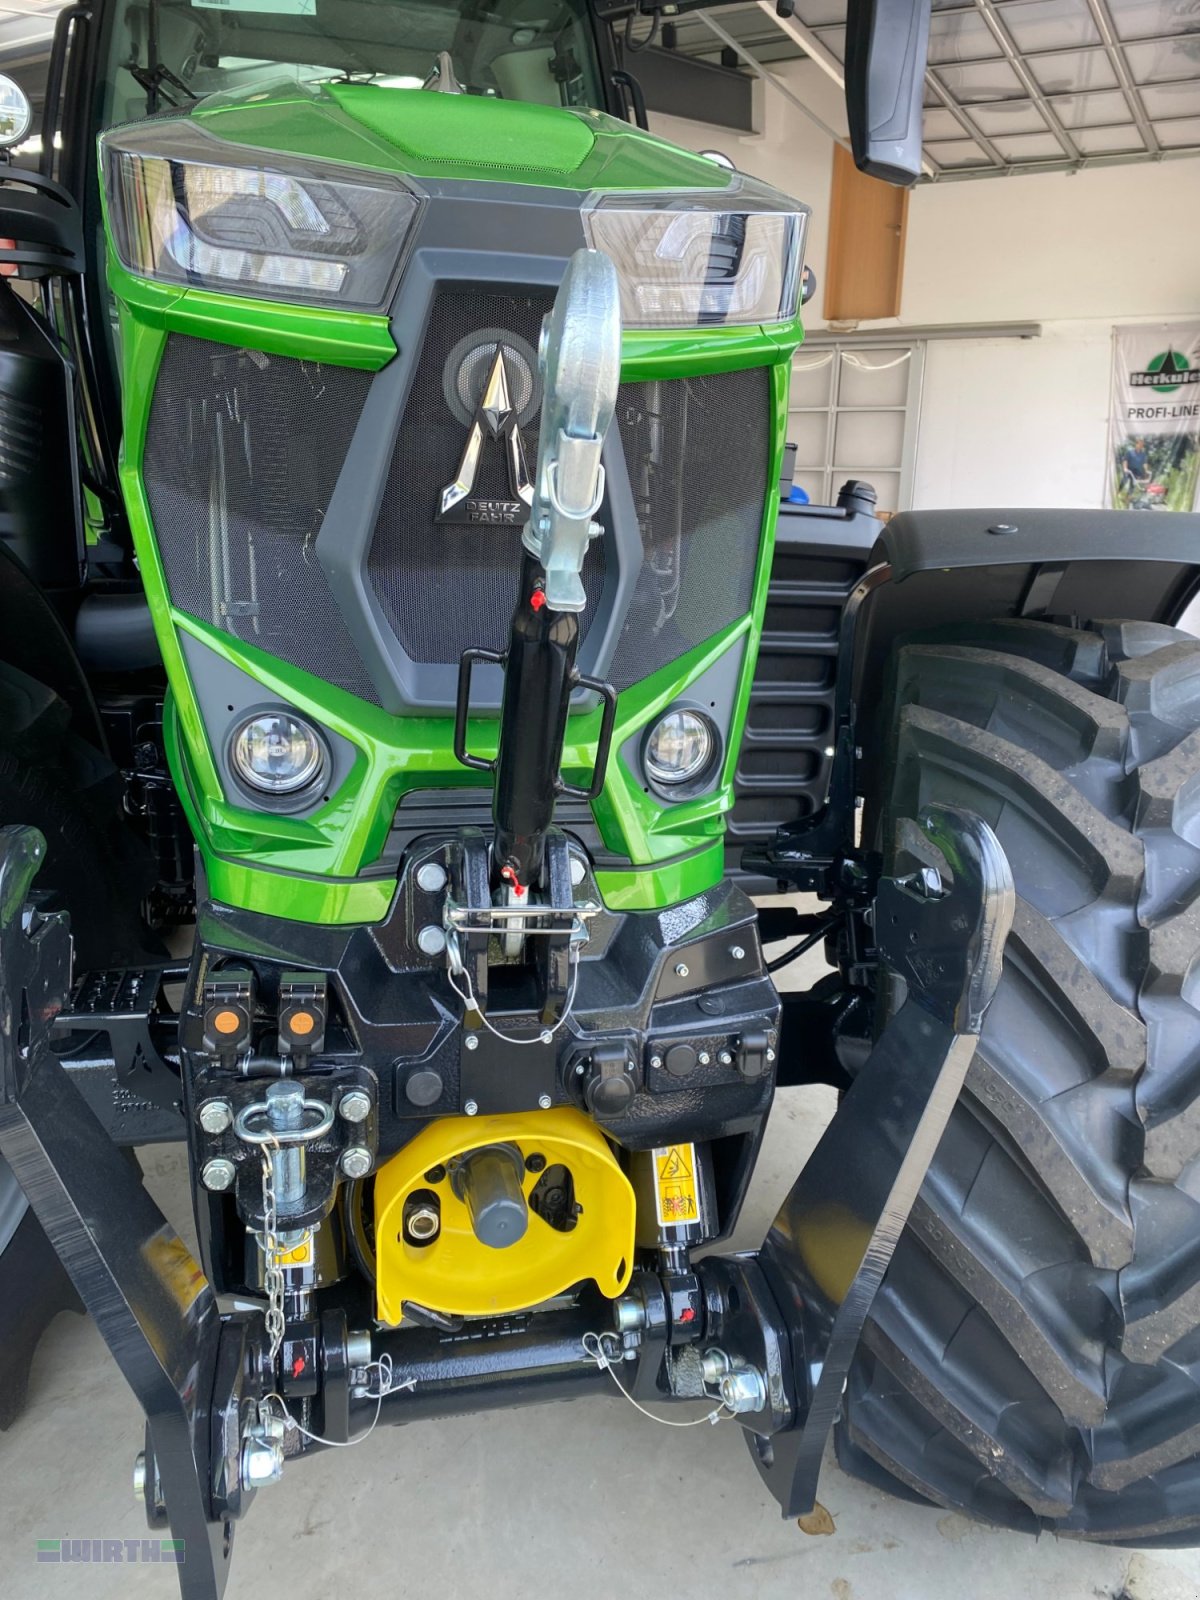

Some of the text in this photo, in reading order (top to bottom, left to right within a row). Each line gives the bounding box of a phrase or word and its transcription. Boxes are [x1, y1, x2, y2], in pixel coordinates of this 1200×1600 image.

[1127, 404, 1200, 419] PROFI-LINE
[466, 501, 521, 512] DEUTZ
[470, 512, 515, 523] FAHR
